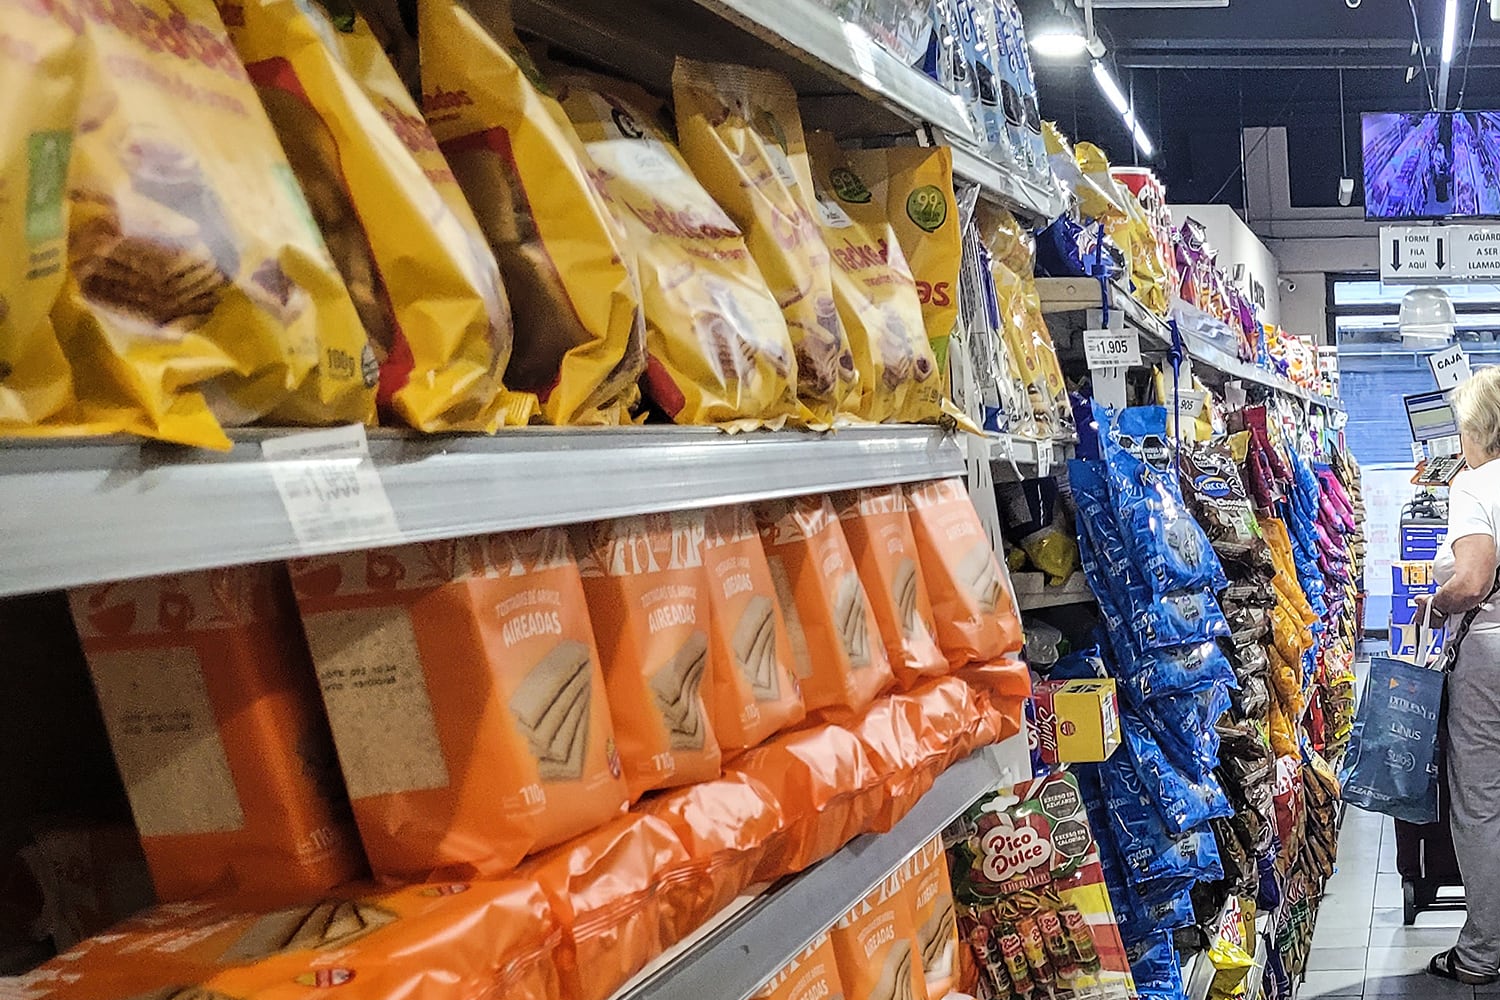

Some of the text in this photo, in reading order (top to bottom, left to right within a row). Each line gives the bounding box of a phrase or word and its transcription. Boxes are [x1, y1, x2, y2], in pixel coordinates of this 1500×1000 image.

[919, 192, 938, 207] 99
[1409, 261, 1427, 269] AQUÍ
[1437, 353, 1462, 369] CAJA
[1452, 373, 1457, 381] 1
[648, 604, 697, 634] AIREADAS
[501, 612, 562, 648] AIREADAS
[989, 833, 1031, 854] Pico
[991, 845, 1042, 875] Dulce
